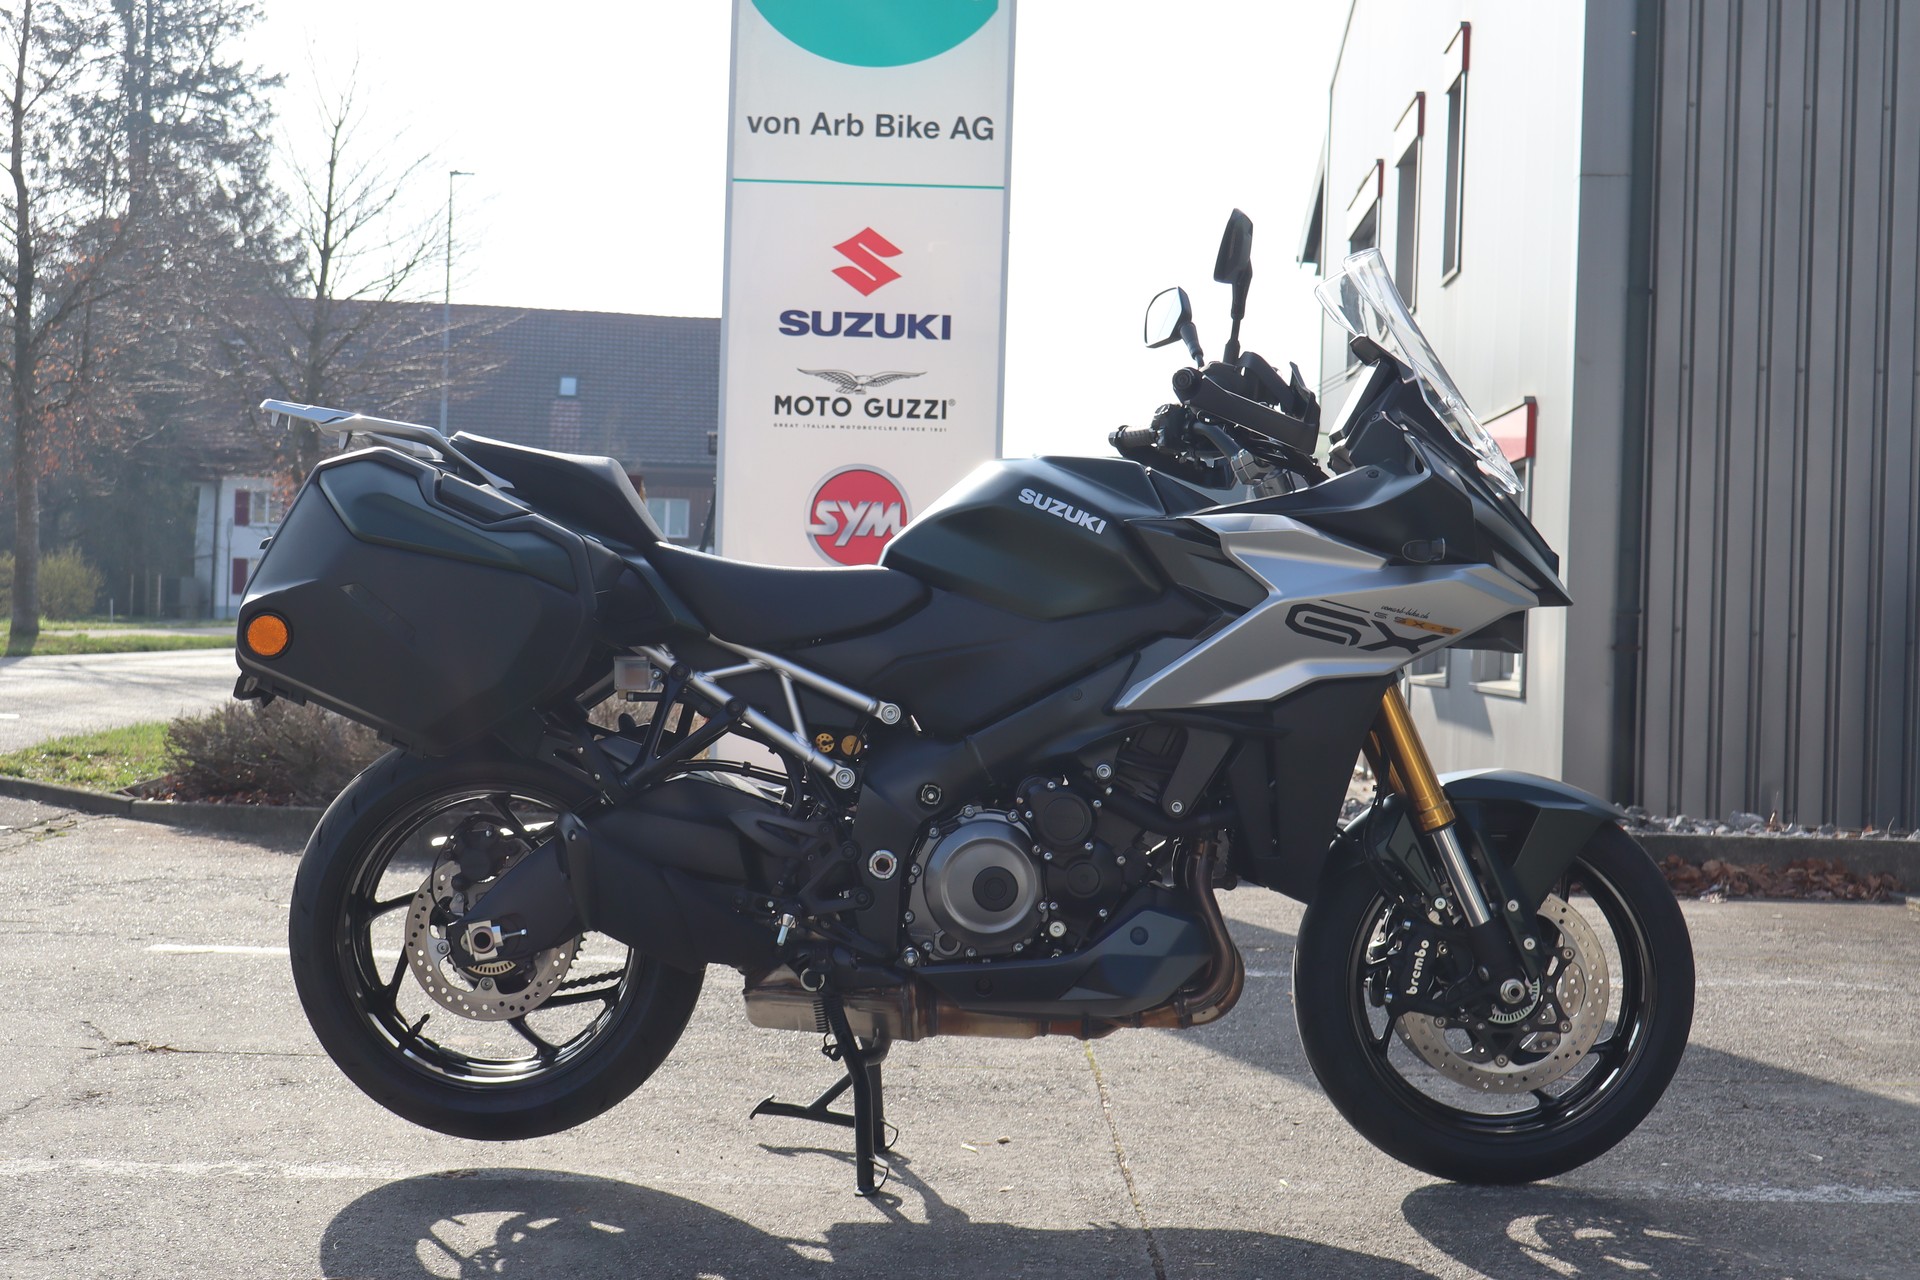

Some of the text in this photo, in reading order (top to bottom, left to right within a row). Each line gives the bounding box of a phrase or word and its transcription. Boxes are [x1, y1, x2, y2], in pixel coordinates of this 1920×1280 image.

[747, 112, 994, 141] von Arb Bike AG
[778, 309, 951, 340] SUZUKI
[774, 395, 852, 418] MOTO
[808, 500, 904, 547] SYM
[1018, 488, 1107, 535] SUZUKI
[1405, 939, 1430, 995] brembo
